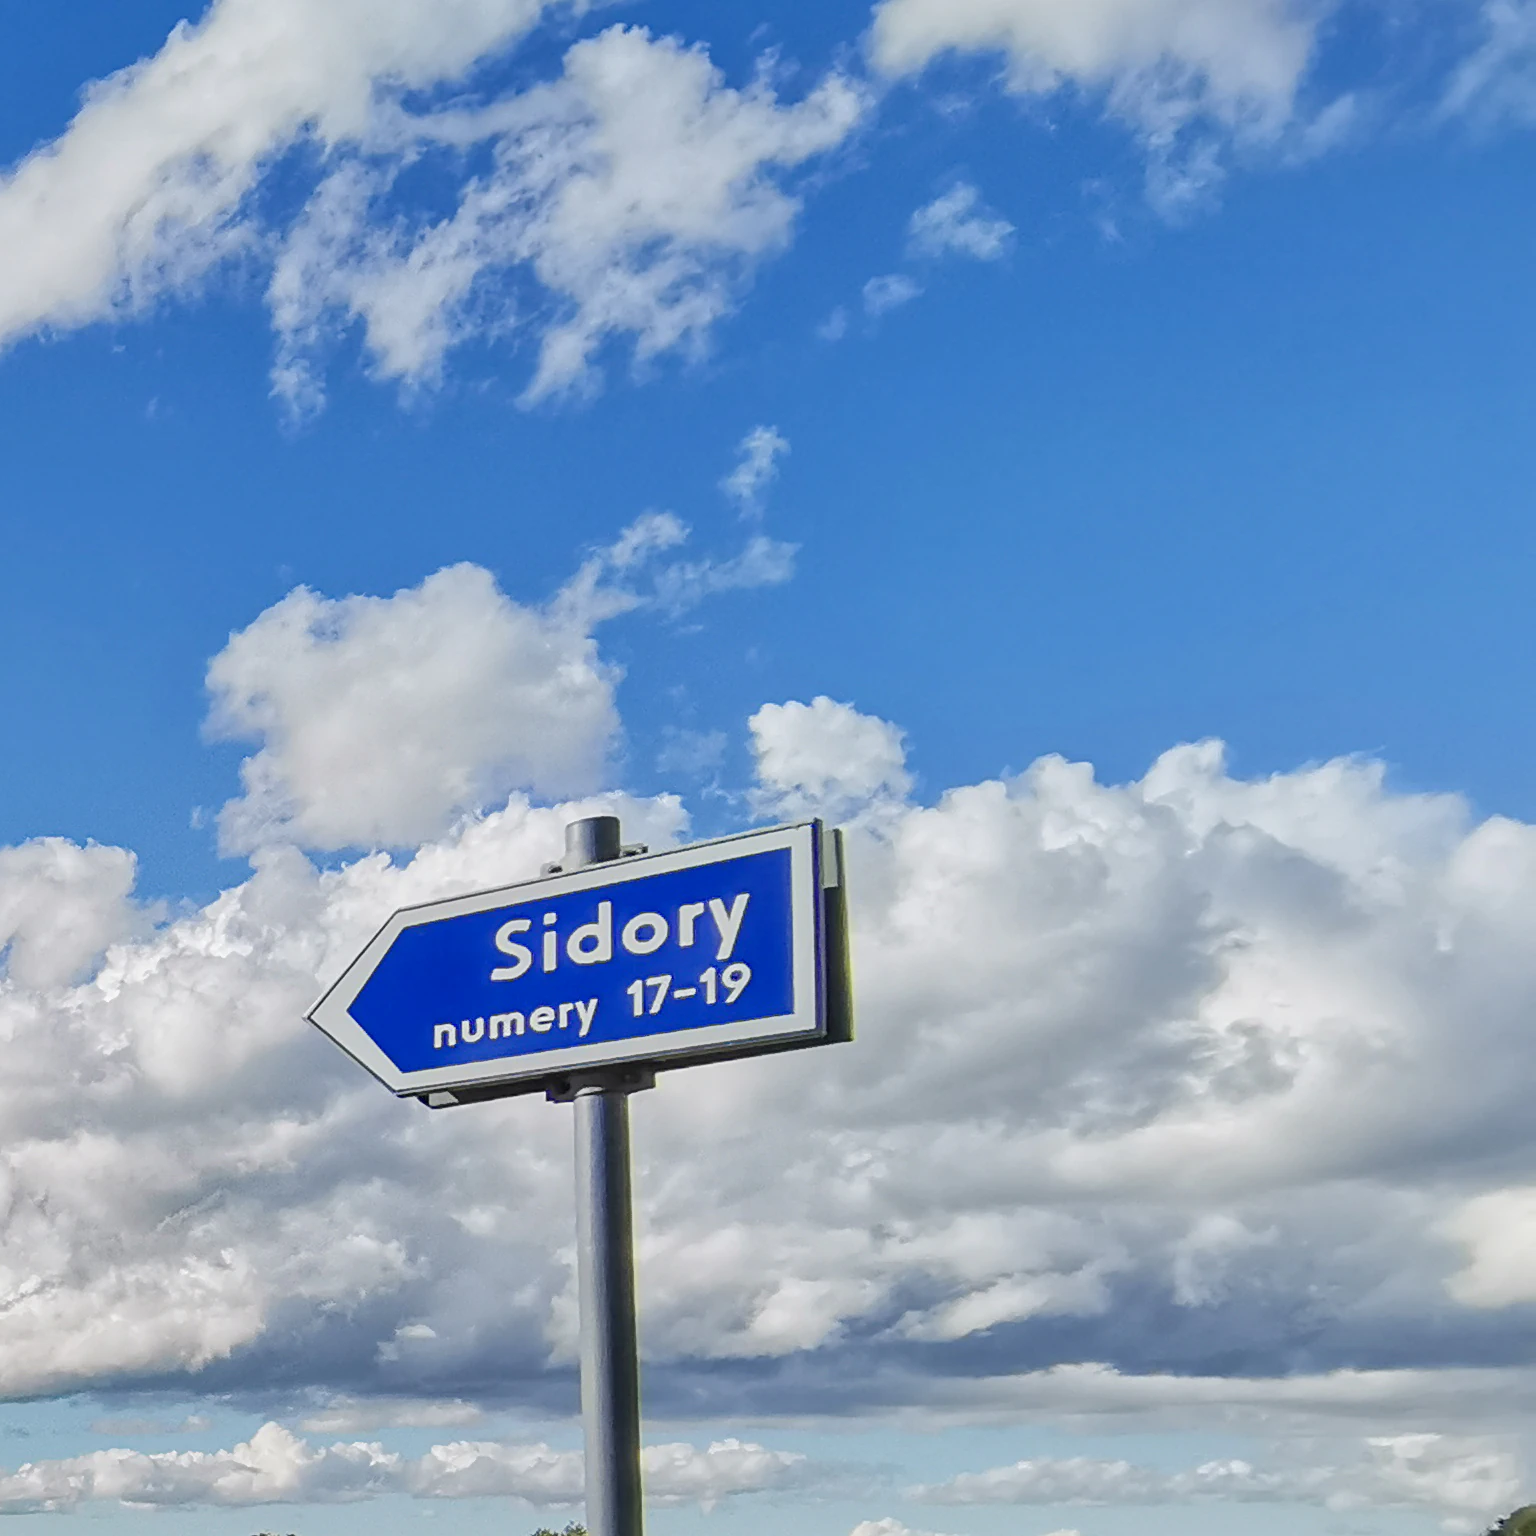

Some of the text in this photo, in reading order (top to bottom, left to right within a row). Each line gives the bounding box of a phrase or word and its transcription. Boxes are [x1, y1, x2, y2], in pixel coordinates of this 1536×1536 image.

[490, 893, 750, 981] Sidory
[433, 962, 751, 1049] numery 17-19
